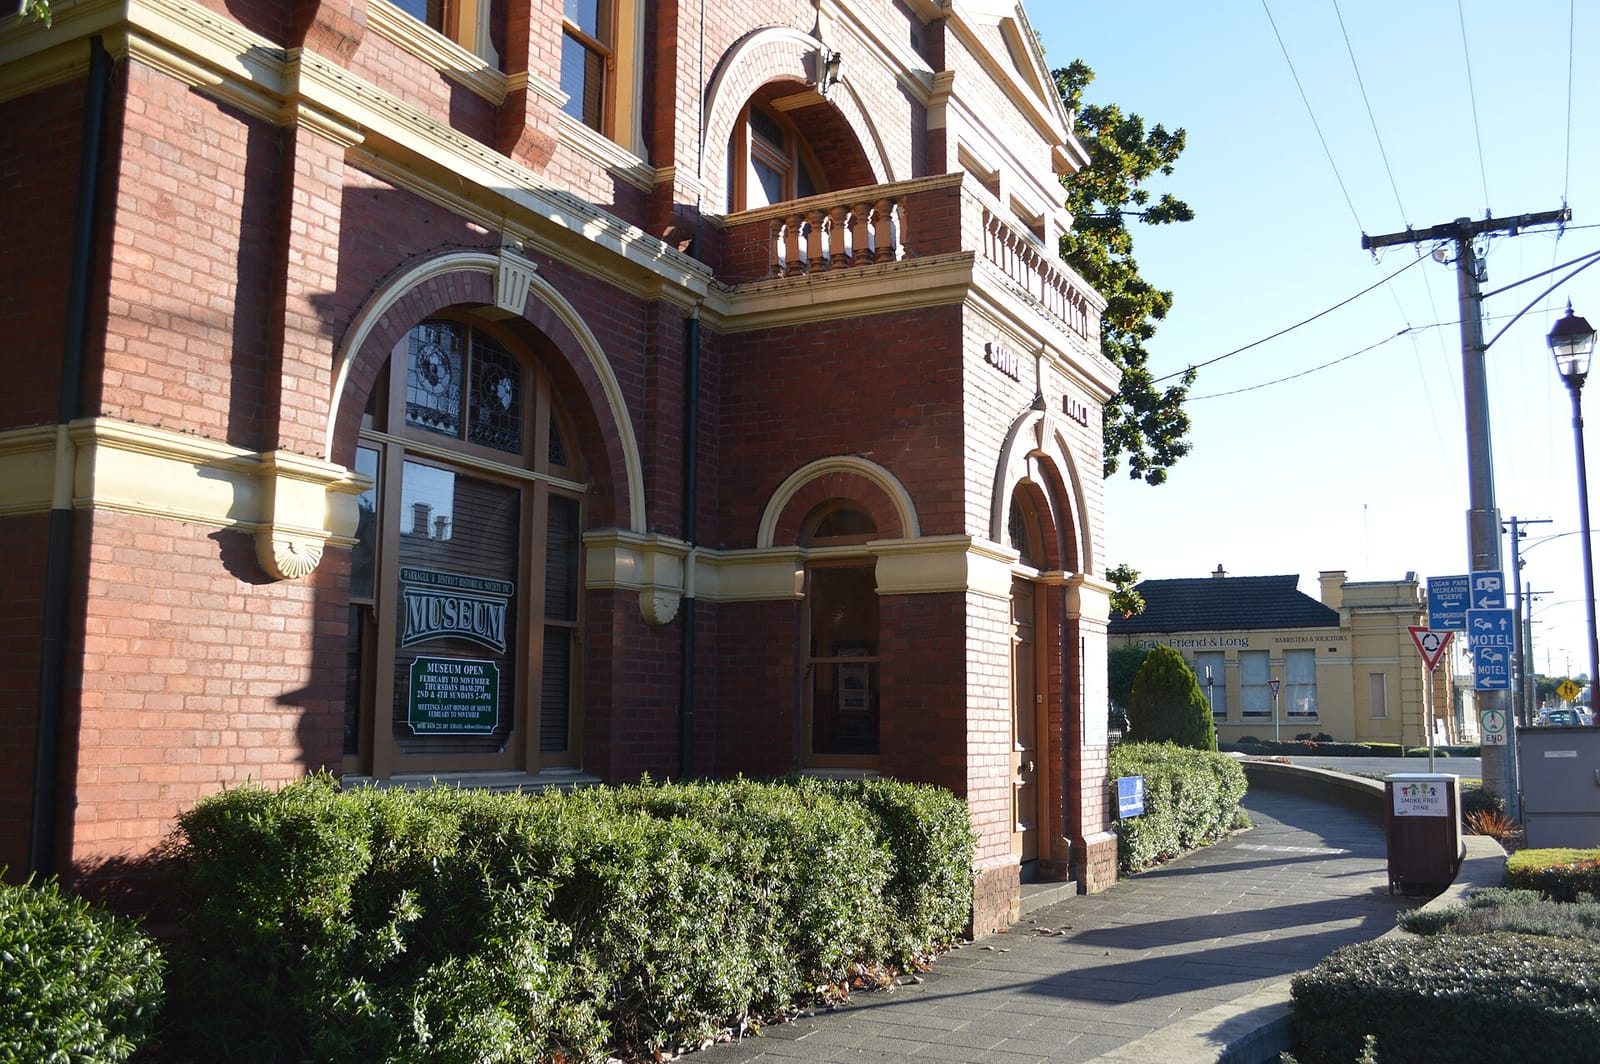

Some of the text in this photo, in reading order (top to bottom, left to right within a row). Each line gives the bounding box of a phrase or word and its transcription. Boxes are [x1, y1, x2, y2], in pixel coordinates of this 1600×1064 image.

[437, 574, 458, 586] DISTRICT
[407, 595, 505, 641] MUSEUM
[1169, 637, 1206, 648] Friend
[1208, 638, 1217, 647] &
[1220, 636, 1249, 648] Long
[1314, 634, 1348, 642] SOLICITORS
[1470, 634, 1513, 645] MOTEL
[427, 663, 483, 675] MUSEUM OPEN
[1478, 665, 1507, 675] MOTEL
[419, 675, 448, 683] FEBRUARY
[460, 677, 490, 685] NOVEMBER
[424, 683, 457, 691] THURSDAYS
[417, 690, 429, 698] 2ND
[437, 691, 448, 699] 4TH
[449, 691, 474, 699] SUNDAYS
[1486, 734, 1503, 742] END
